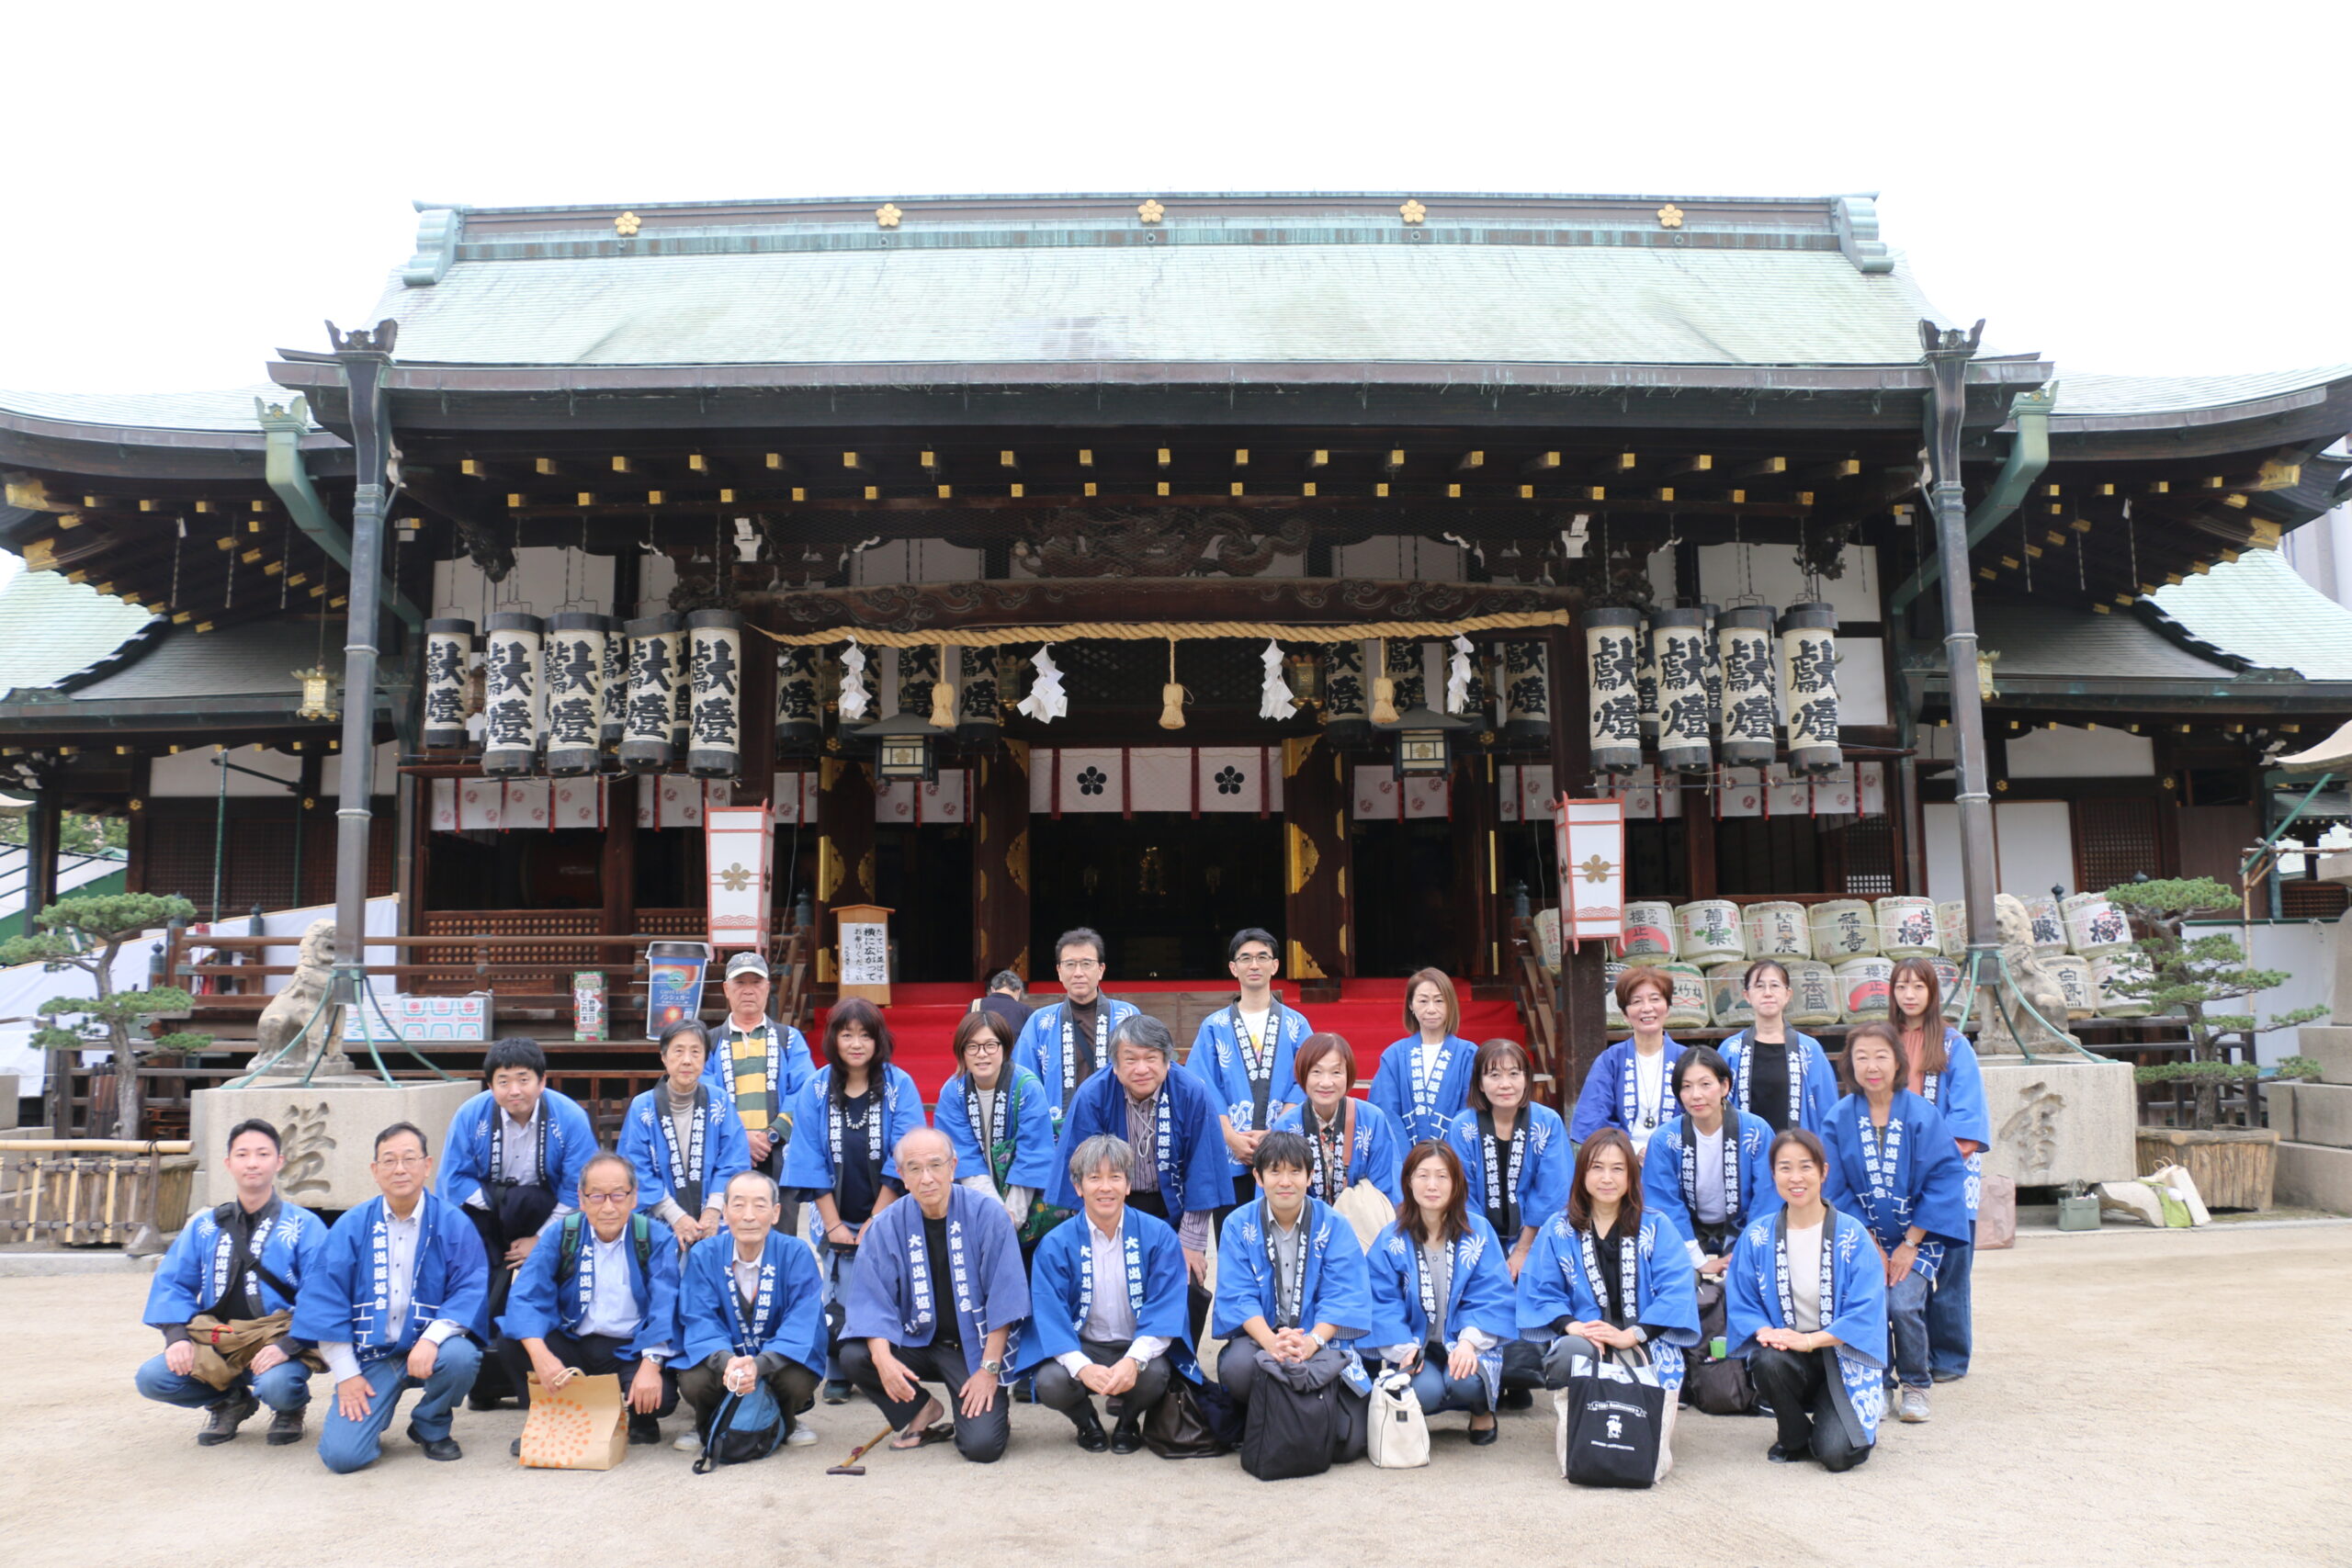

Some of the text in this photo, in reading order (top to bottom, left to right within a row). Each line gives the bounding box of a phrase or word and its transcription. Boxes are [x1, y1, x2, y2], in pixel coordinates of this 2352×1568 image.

[864, 928, 876, 981] 横に広がって
[1801, 971, 1827, 1010] 日本盛
[766, 1027, 778, 1091] 大阪出版協会
[1062, 1022, 1075, 1088] 大阪出版協会
[1234, 1018, 1259, 1081] 大阪出版協会
[1259, 1014, 1278, 1079] 大阪出版協会
[1411, 1047, 1427, 1115] 大阪出版協会
[1788, 1051, 1801, 1122] 大阪出版協会
[660, 1115, 686, 1188] 大阪出版協会
[689, 1106, 705, 1181] 大阪出版協会
[1157, 1093, 1170, 1172] 大阪出版協会
[1508, 1128, 1525, 1204] 大阪出版協会
[1859, 1116, 1886, 1198] 大阪出版協会
[1484, 1134, 1500, 1209] 大阪出版協会
[1724, 1138, 1738, 1215] 大阪出版協会
[215, 1233, 232, 1303] 大阪出版協
[245, 1217, 272, 1295] 大阪出協会
[373, 1221, 387, 1310] 大阪出版協会
[908, 1234, 931, 1323] 大阪出版協会
[950, 1221, 972, 1311] 大阪出版協会
[1073, 1245, 1092, 1331] 大阪出版協会
[1125, 1236, 1143, 1318] 大阪出版協
[1581, 1230, 1608, 1307] 大阪出版協会
[1621, 1237, 1636, 1318] 大阪出版協会
[1776, 1239, 1795, 1325] 大阪出版協会
[1821, 1239, 1833, 1325] 大阪出版協会
